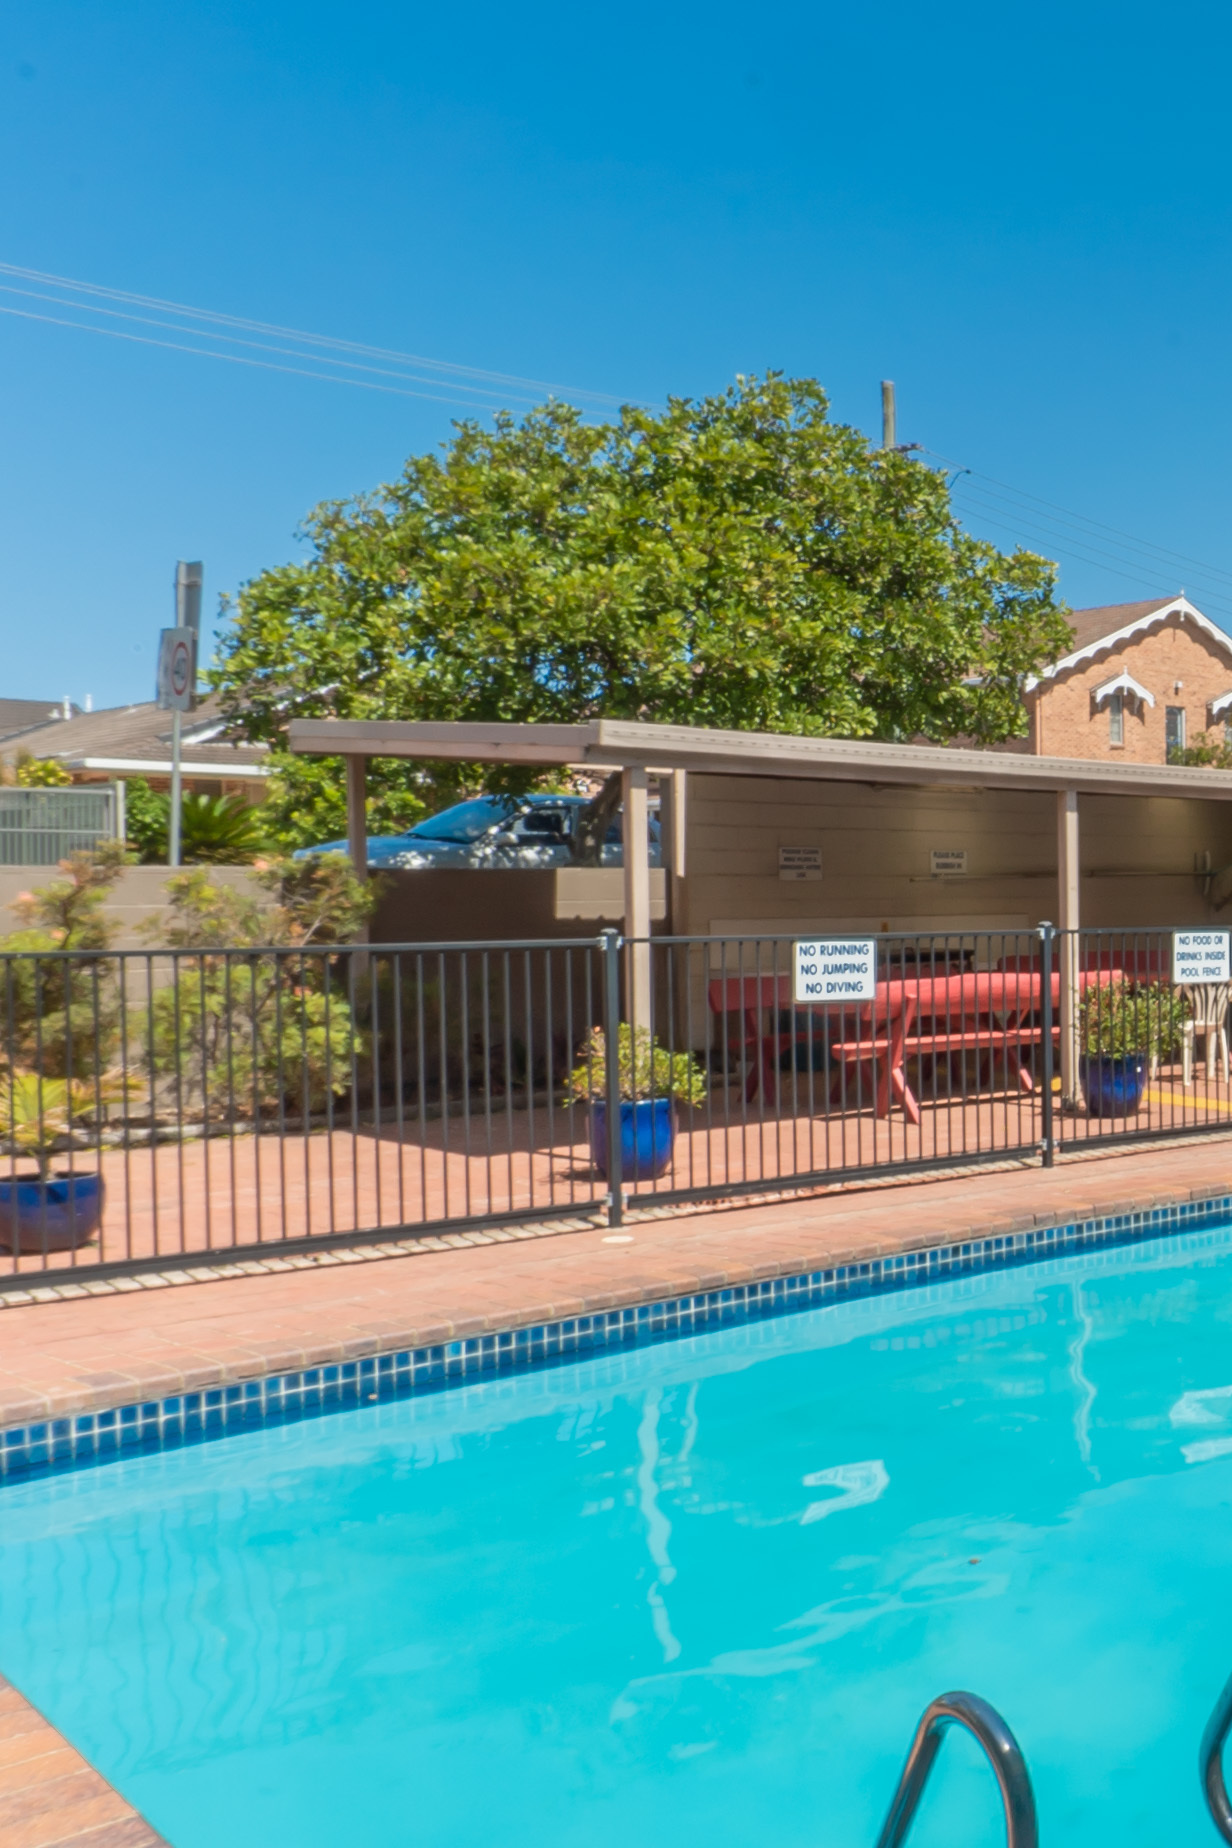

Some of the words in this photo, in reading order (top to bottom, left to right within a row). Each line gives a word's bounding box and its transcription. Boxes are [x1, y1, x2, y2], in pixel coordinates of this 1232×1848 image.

[1179, 936, 1191, 945] NO
[1193, 935, 1212, 945] FOOD
[1214, 935, 1223, 945] OR
[799, 945, 816, 956] NO
[820, 944, 869, 956] RUNNING
[1176, 951, 1202, 961] DRINKS
[1204, 951, 1225, 960] INSIDE
[801, 964, 817, 975] NO
[822, 963, 868, 975] JUMPING
[1181, 967, 1199, 977] POOL
[1202, 966, 1222, 976] FENCE
[805, 982, 822, 994] NO
[826, 981, 863, 993] DIVING
